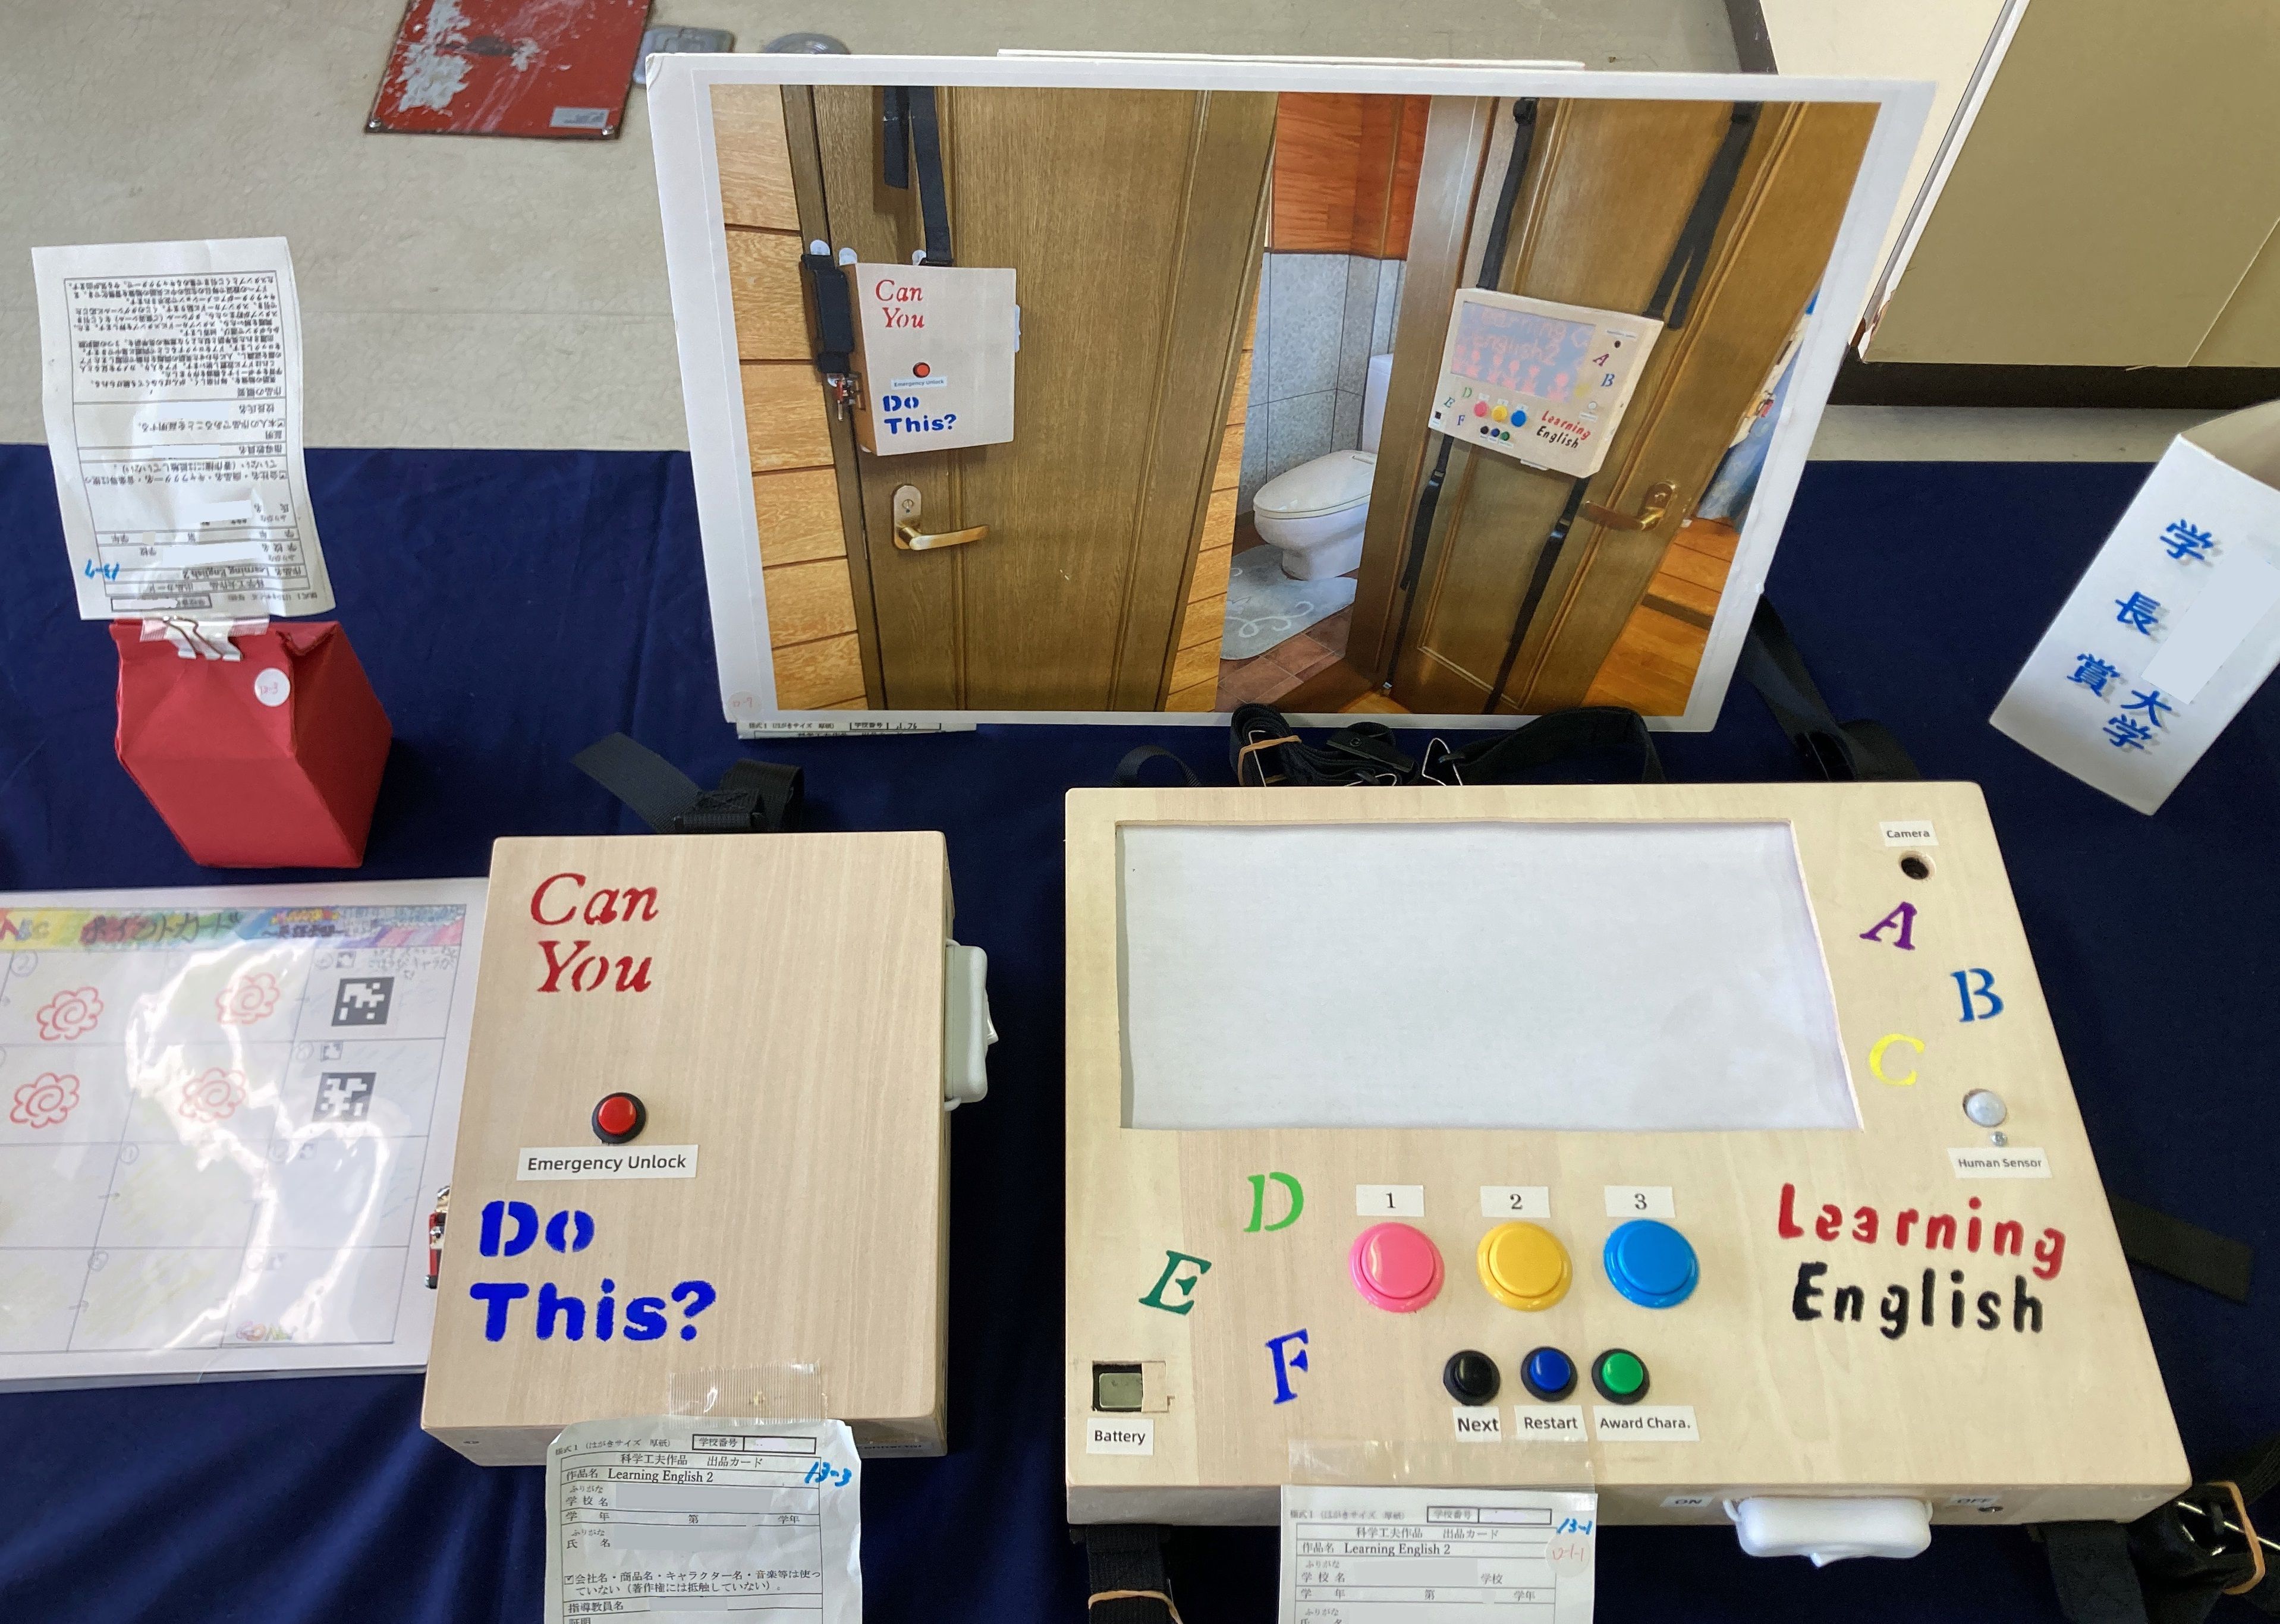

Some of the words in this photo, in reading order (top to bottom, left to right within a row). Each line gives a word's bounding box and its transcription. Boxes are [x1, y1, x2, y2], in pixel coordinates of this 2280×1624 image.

[875, 279, 923, 302] Can
[882, 307, 924, 329] You
[1592, 354, 1609, 367] A
[1600, 373, 1615, 386] B
[1462, 387, 1473, 398] D
[883, 395, 919, 412] Do
[884, 414, 957, 435] This?
[1457, 415, 1466, 426] F
[1542, 410, 1591, 440] Learning
[1536, 426, 1579, 449] English
[1886, 828, 1930, 839] Camera
[530, 872, 659, 926] Can
[1859, 902, 1917, 951] A
[537, 940, 652, 993] You
[1950, 968, 2004, 1022] B
[1869, 1033, 1926, 1086] C
[527, 1156, 622, 1174] Emergency
[628, 1154, 687, 1170] Unlock
[1957, 1157, 2000, 1169] Human
[2002, 1157, 2043, 1169] Sensor
[1243, 1172, 1304, 1233] D
[1386, 1192, 1396, 1209] 1
[1509, 1194, 1524, 1210] 2
[1634, 1193, 1649, 1210] 3
[479, 1200, 595, 1258] Do
[1778, 1182, 2067, 1280] Learning
[1139, 1249, 1212, 1316] E
[1792, 1261, 2043, 1340] English
[469, 1277, 716, 1343] This?
[1265, 1328, 1309, 1405] F
[1457, 1417, 1499, 1433] Next
[1523, 1416, 1578, 1430] Restart
[1599, 1417, 1643, 1429] Award
[1647, 1417, 1691, 1430] Chara.
[699, 1437, 738, 1448] 学校番号
[1093, 1429, 1146, 1446] Battery
[619, 1453, 688, 1466] 科学工夫作品
[706, 1455, 764, 1468] 出品カード
[566, 1468, 599, 1481] 作品名
[608, 1468, 659, 1483] Learning
[662, 1470, 704, 1484] English
[706, 1471, 713, 1483] 2
[569, 1485, 604, 1494] ふりがな
[687, 1513, 699, 1525] 第
[778, 1513, 800, 1524] 学年
[1356, 1527, 1423, 1539] 科学工夫作品
[1443, 1528, 1499, 1540] 出品カード
[1302, 1542, 1334, 1554] 作品名
[1344, 1543, 1395, 1557] Learning
[1398, 1543, 1441, 1557] English
[1444, 1544, 1451, 1555] 2
[1480, 1573, 1503, 1585] 学校
[568, 1601, 624, 1613] 指導教員名
